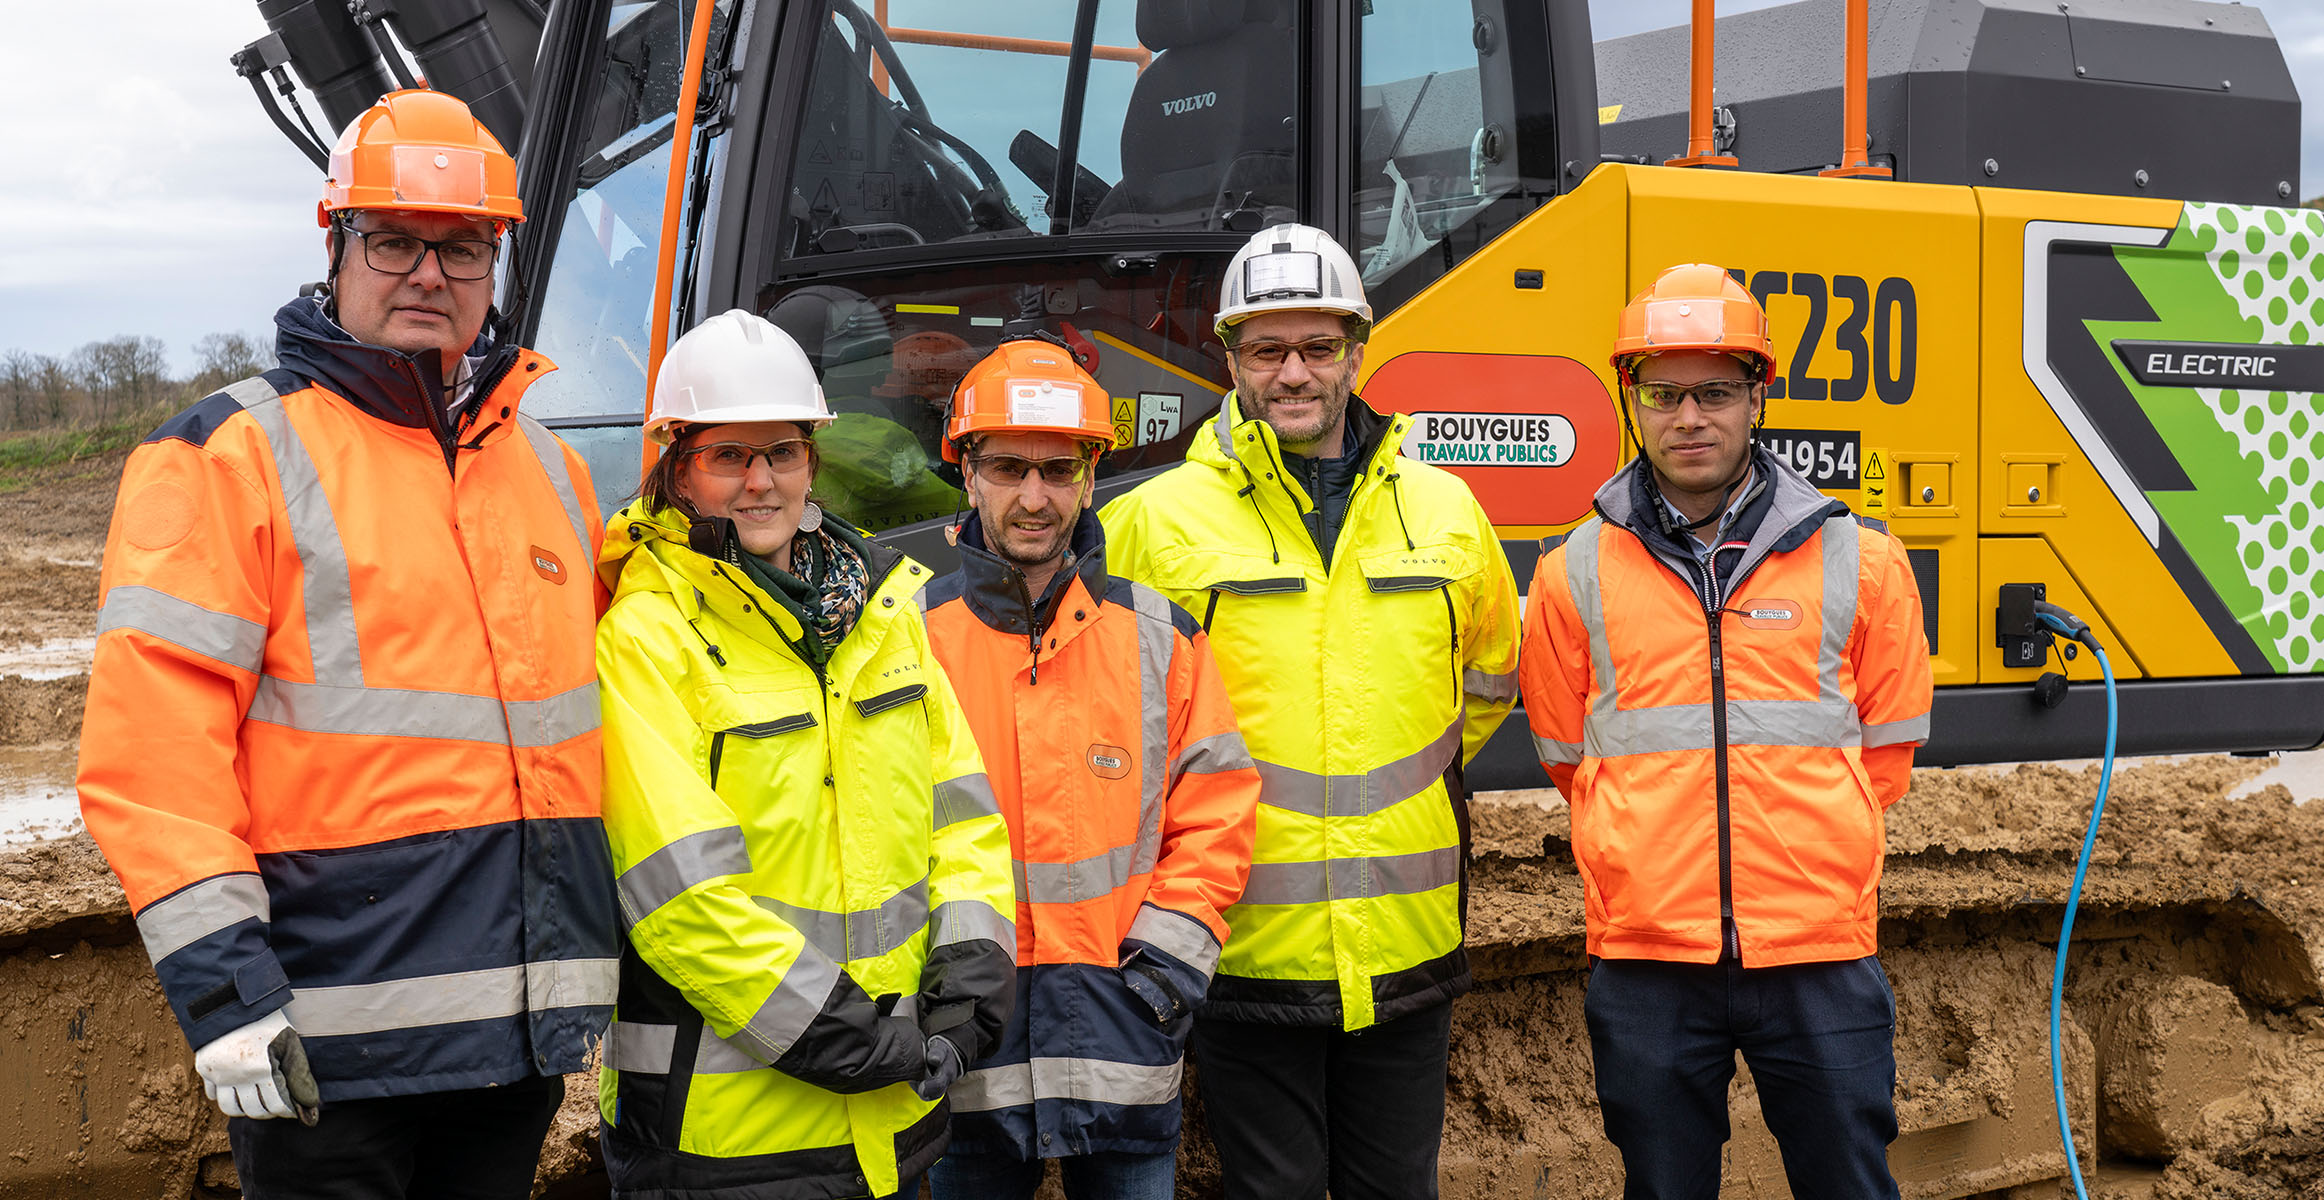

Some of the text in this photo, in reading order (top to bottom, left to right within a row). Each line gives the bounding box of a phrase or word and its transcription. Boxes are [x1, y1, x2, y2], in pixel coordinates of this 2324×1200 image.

[1161, 91, 1216, 116] VOLVO
[1727, 268, 1917, 405] C230
[2147, 353, 2276, 376] ELECTRIC
[1146, 418, 1168, 443] 97
[1427, 417, 1549, 442] BOUYGUES
[1418, 443, 1557, 463] TRAVAUX PUBLICS
[882, 664, 921, 678] VOLV
